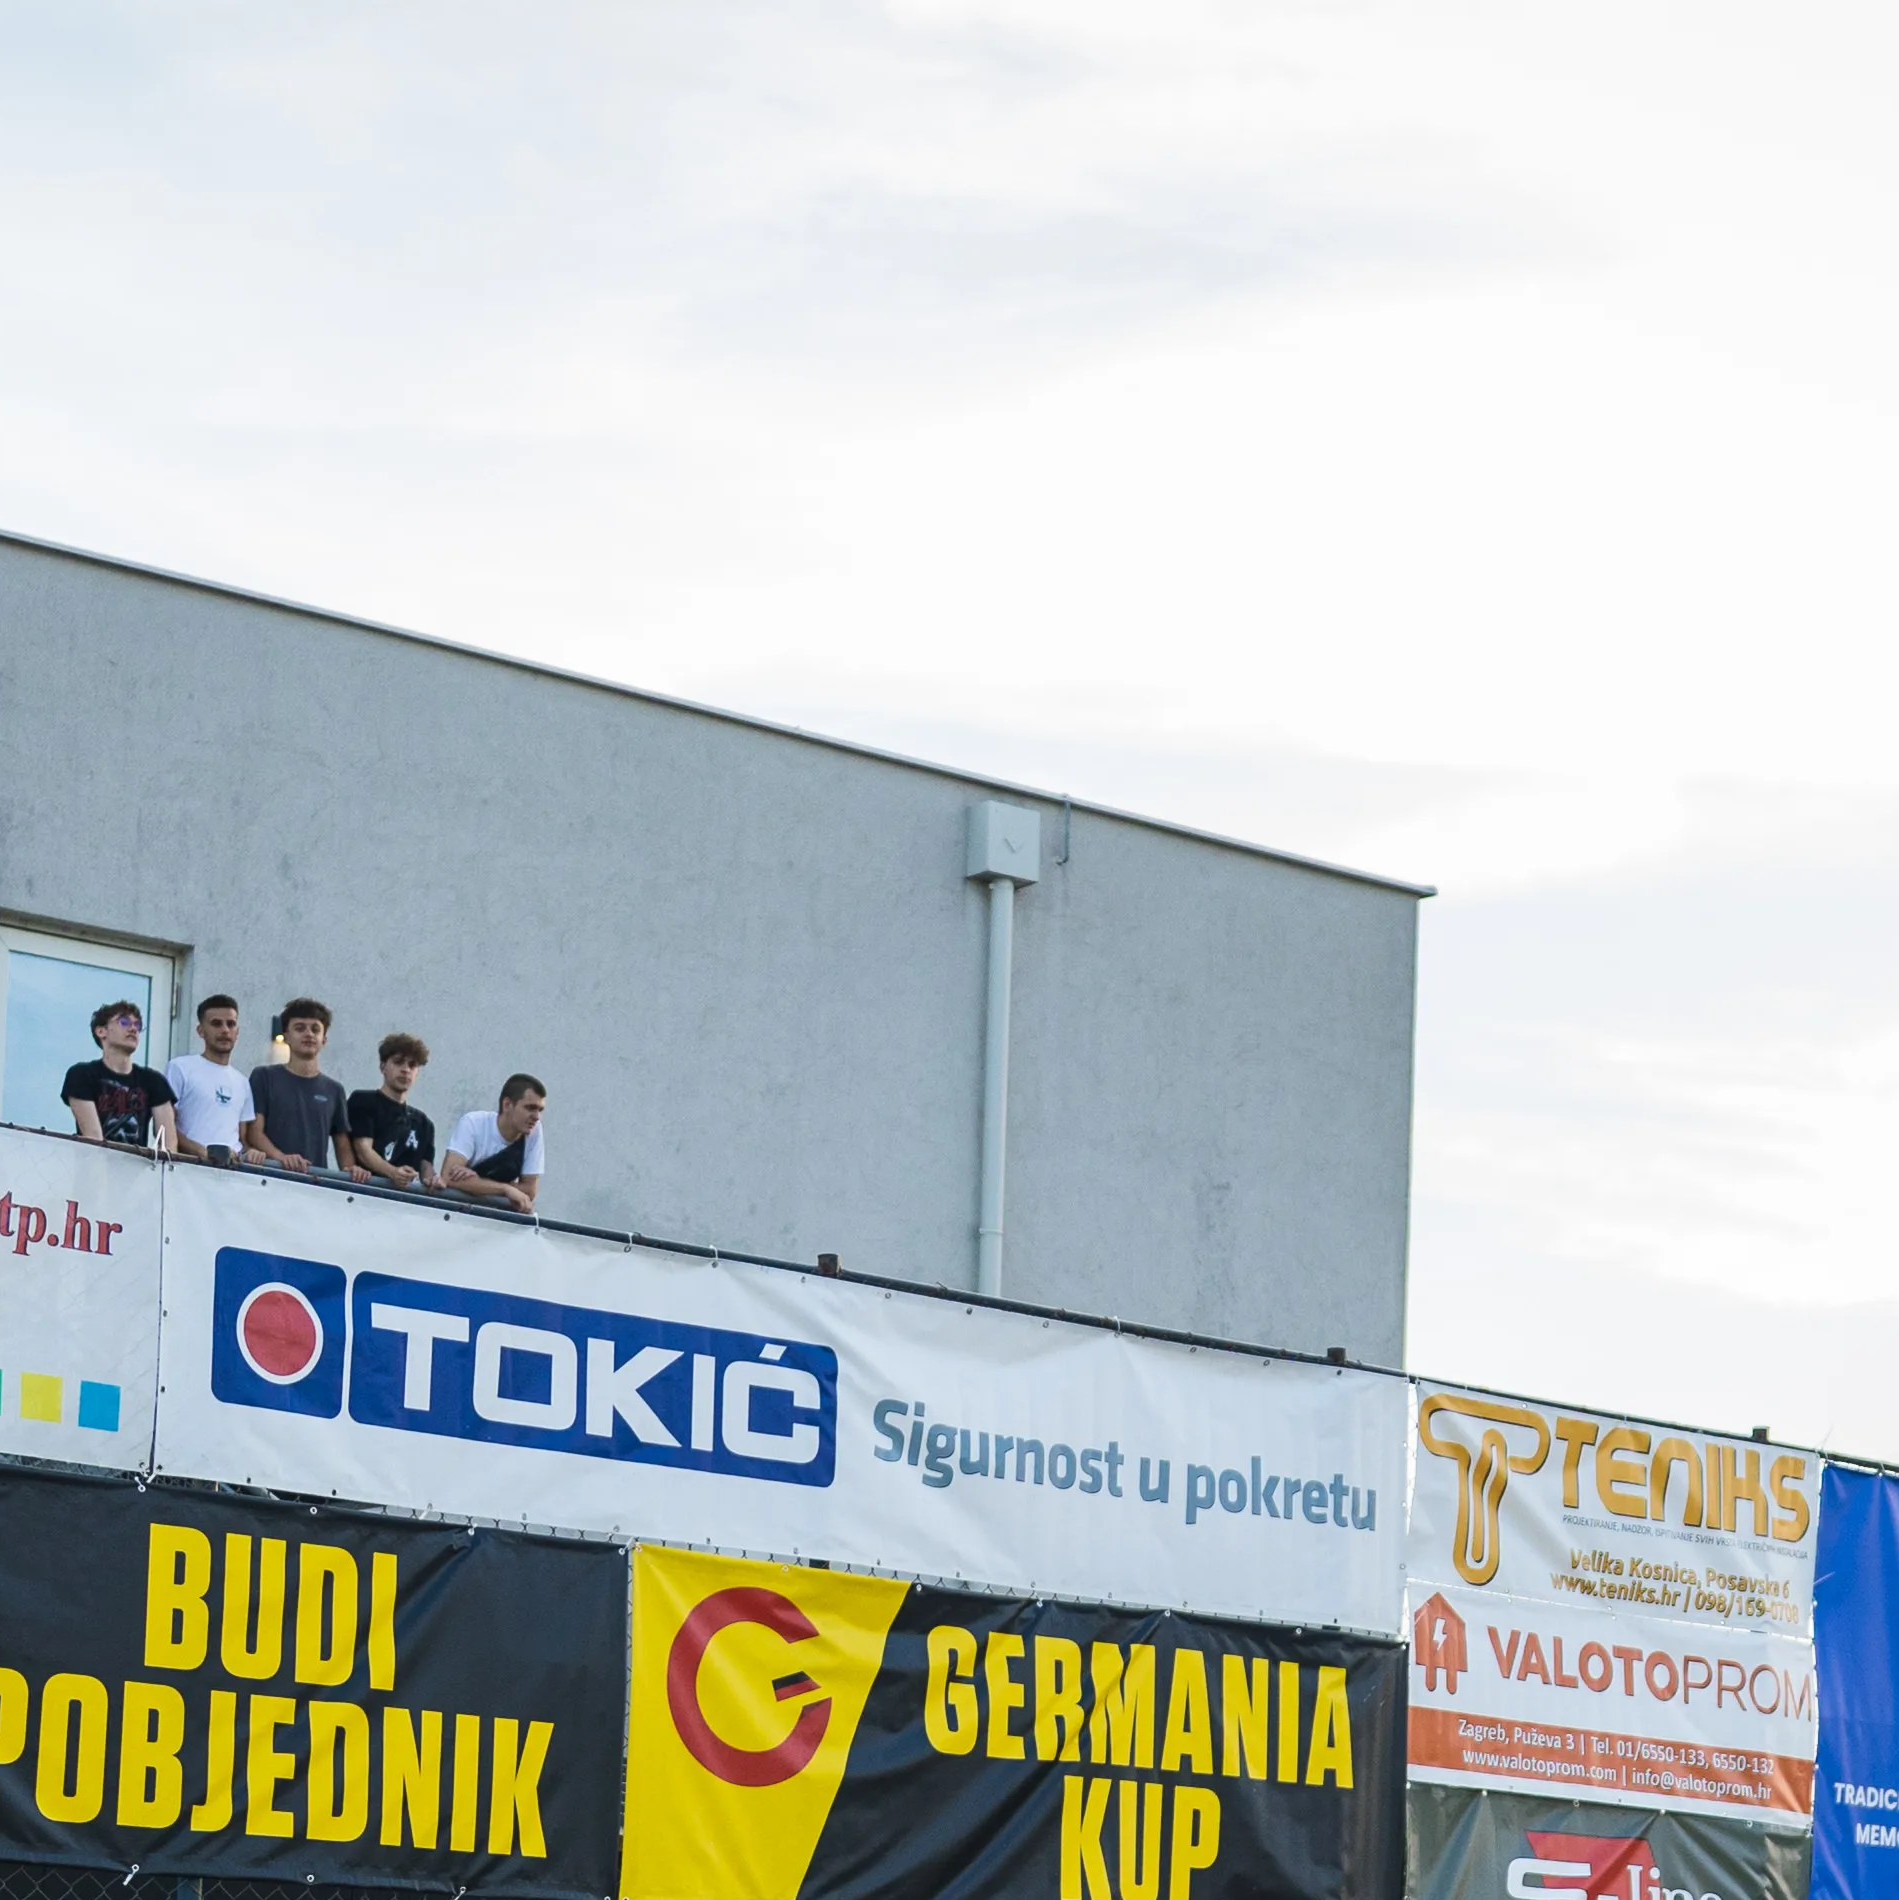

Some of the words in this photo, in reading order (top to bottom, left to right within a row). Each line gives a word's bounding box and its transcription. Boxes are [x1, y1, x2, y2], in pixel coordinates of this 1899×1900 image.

[371, 1301, 820, 1464] TOKIĆ
[873, 1397, 1124, 1498] Sigurnost
[1139, 1457, 1169, 1503] u
[1185, 1456, 1377, 1532] pokretu
[144, 1522, 397, 1692] BUDI
[1550, 1572, 1681, 1608] www.teniks.hr
[1694, 1589, 1800, 1625] 098/169-0708
[1570, 1548, 1624, 1576] Velika
[1705, 1567, 1781, 1599] Posavska
[1782, 1580, 1791, 1599] 6
[924, 1624, 1355, 1790] GERMANIA
[1487, 1625, 1813, 1722] VALOTOPROM
[1458, 1719, 1510, 1744] Zagreb,
[1513, 1726, 1563, 1751] Puževa
[1566, 1734, 1575, 1750] 3
[1590, 1737, 1614, 1755] Tel.
[1712, 1754, 1776, 1776] 6550-132
[1462, 1750, 1618, 1782] www.valotoprom.com
[1631, 1767, 1773, 1801] info@valotoprom.hr
